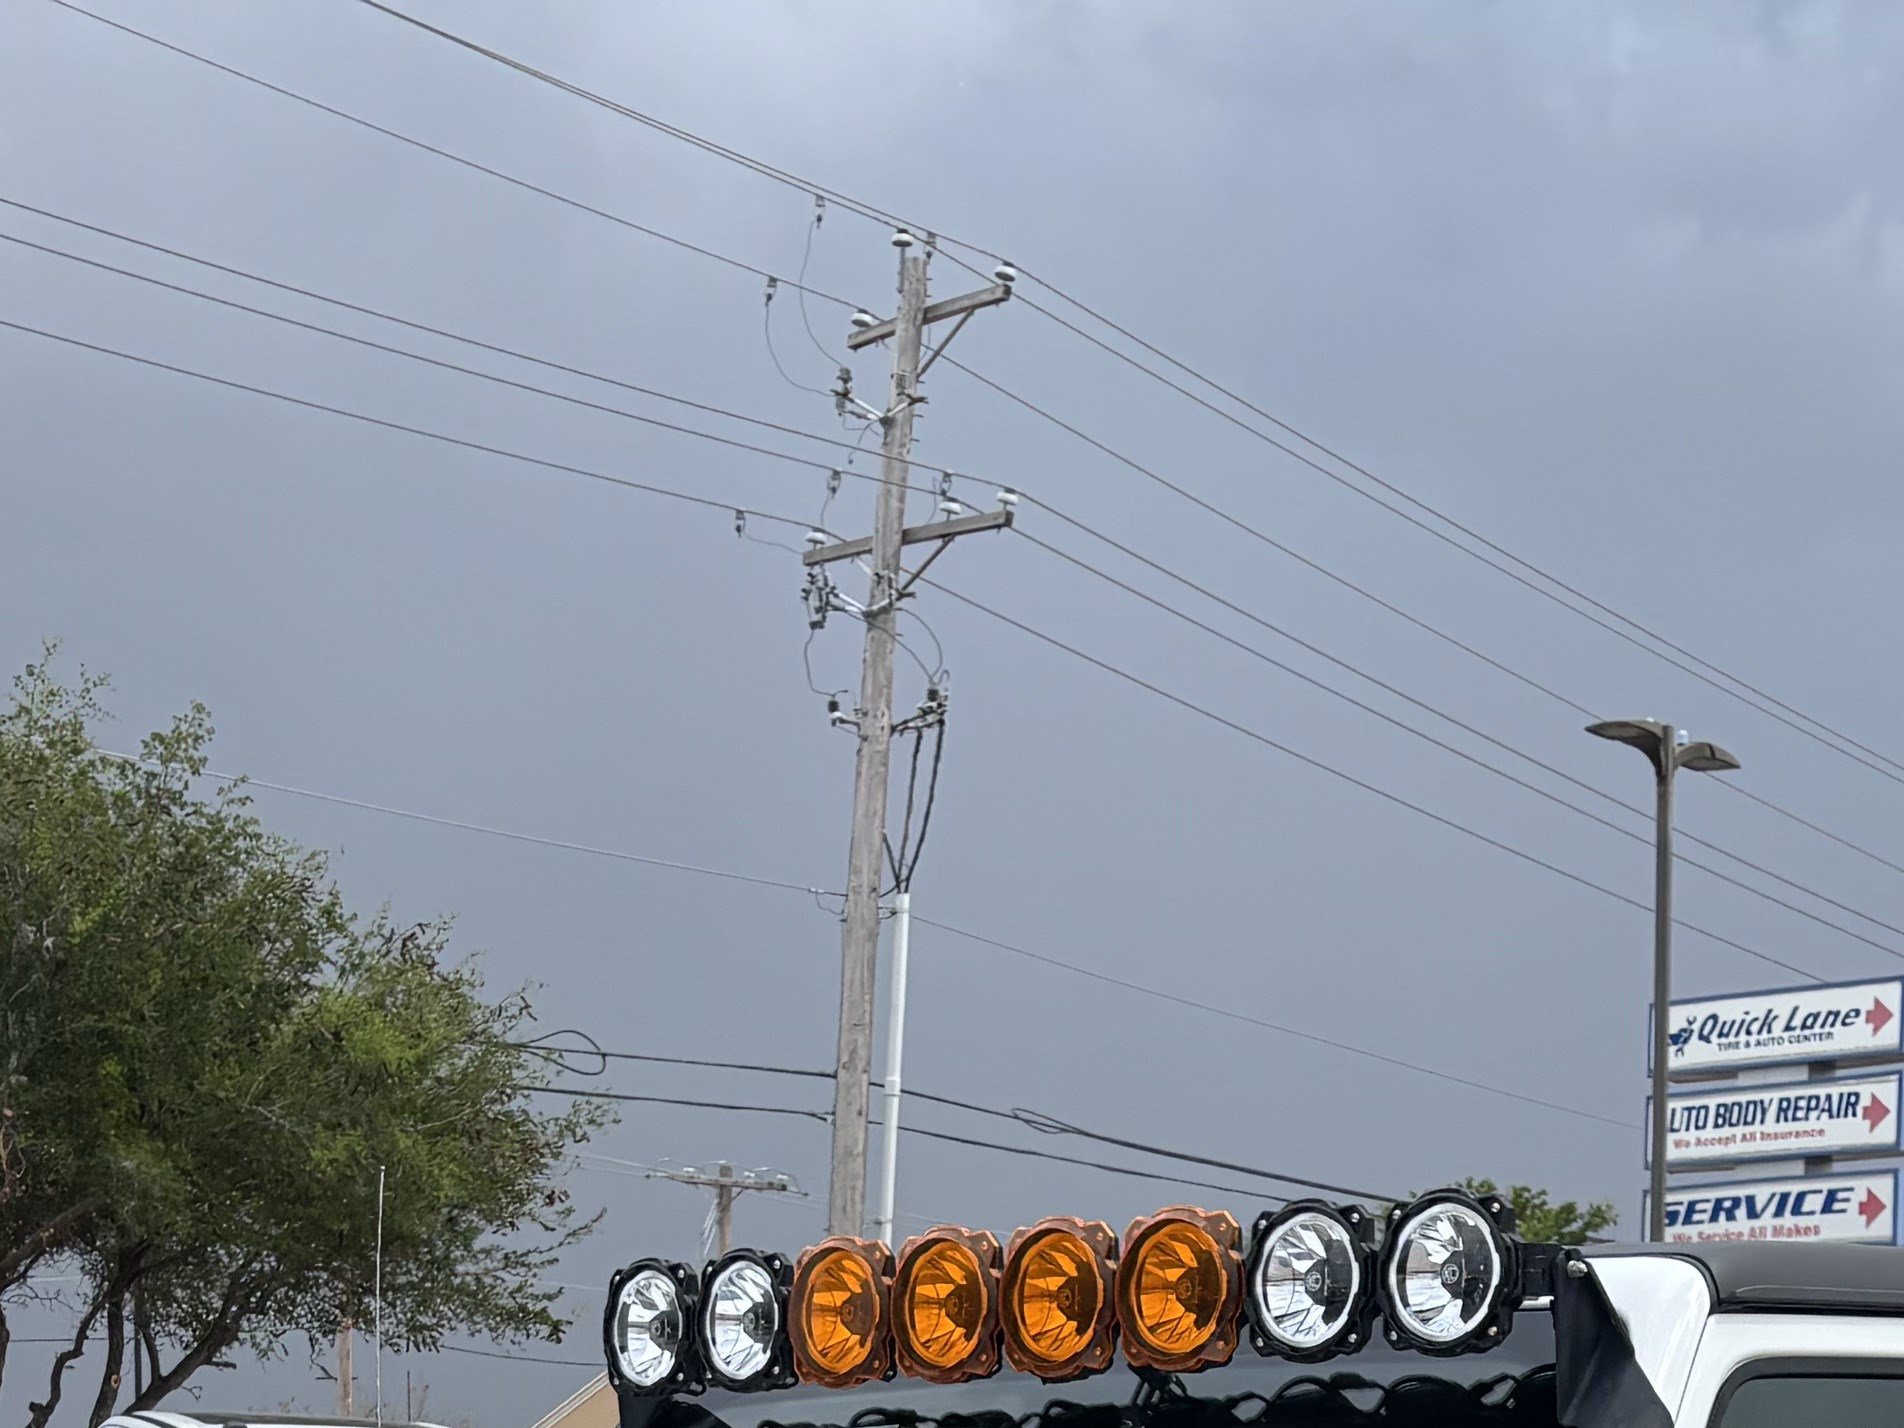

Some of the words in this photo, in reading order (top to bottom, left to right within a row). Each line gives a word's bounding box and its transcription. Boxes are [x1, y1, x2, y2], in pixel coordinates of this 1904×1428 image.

[1698, 1008, 1780, 1044] Quick
[1783, 1005, 1861, 1033] Lane
[1717, 1040, 1741, 1052] TIRE
[1754, 1036, 1785, 1048] AUTO
[1788, 1031, 1834, 1045] CENTER
[1668, 1105, 1709, 1133] UTO
[1713, 1098, 1773, 1129] BODY
[1775, 1091, 1861, 1124] REPAIR
[1664, 1187, 1854, 1227] SERVICE
